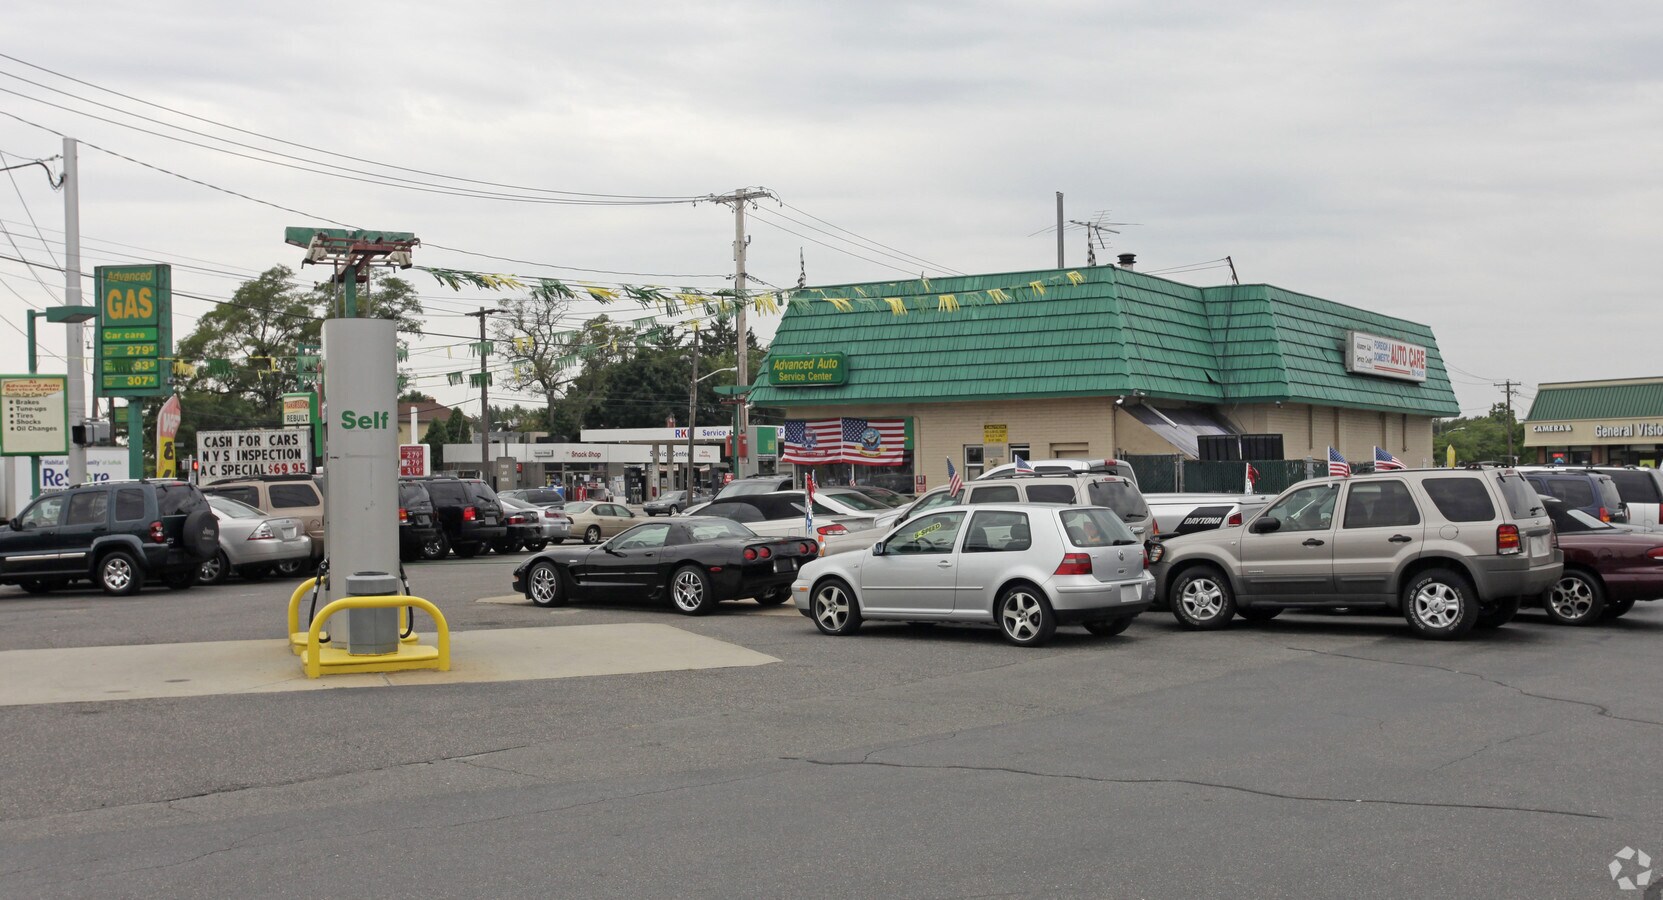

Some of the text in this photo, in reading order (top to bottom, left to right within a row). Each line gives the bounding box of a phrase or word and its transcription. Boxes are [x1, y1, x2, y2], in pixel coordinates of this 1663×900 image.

[107, 270, 153, 282] Advanced
[107, 287, 153, 319] GAS
[104, 331, 121, 339] Car
[1391, 344, 1425, 369] AUTO CARE
[773, 357, 838, 371] Advanced Auto
[778, 371, 833, 381] Service Center
[286, 414, 309, 422] REBUILT
[341, 410, 389, 429] Self
[702, 429, 727, 437] Service
[1595, 424, 1634, 437] General
[204, 434, 299, 448] CASH FOR CARS
[237, 449, 302, 461] INSPECTION
[588, 451, 602, 459] Shop
[221, 464, 267, 476] SPECIAL
[1183, 517, 1222, 525] DAYTONA
